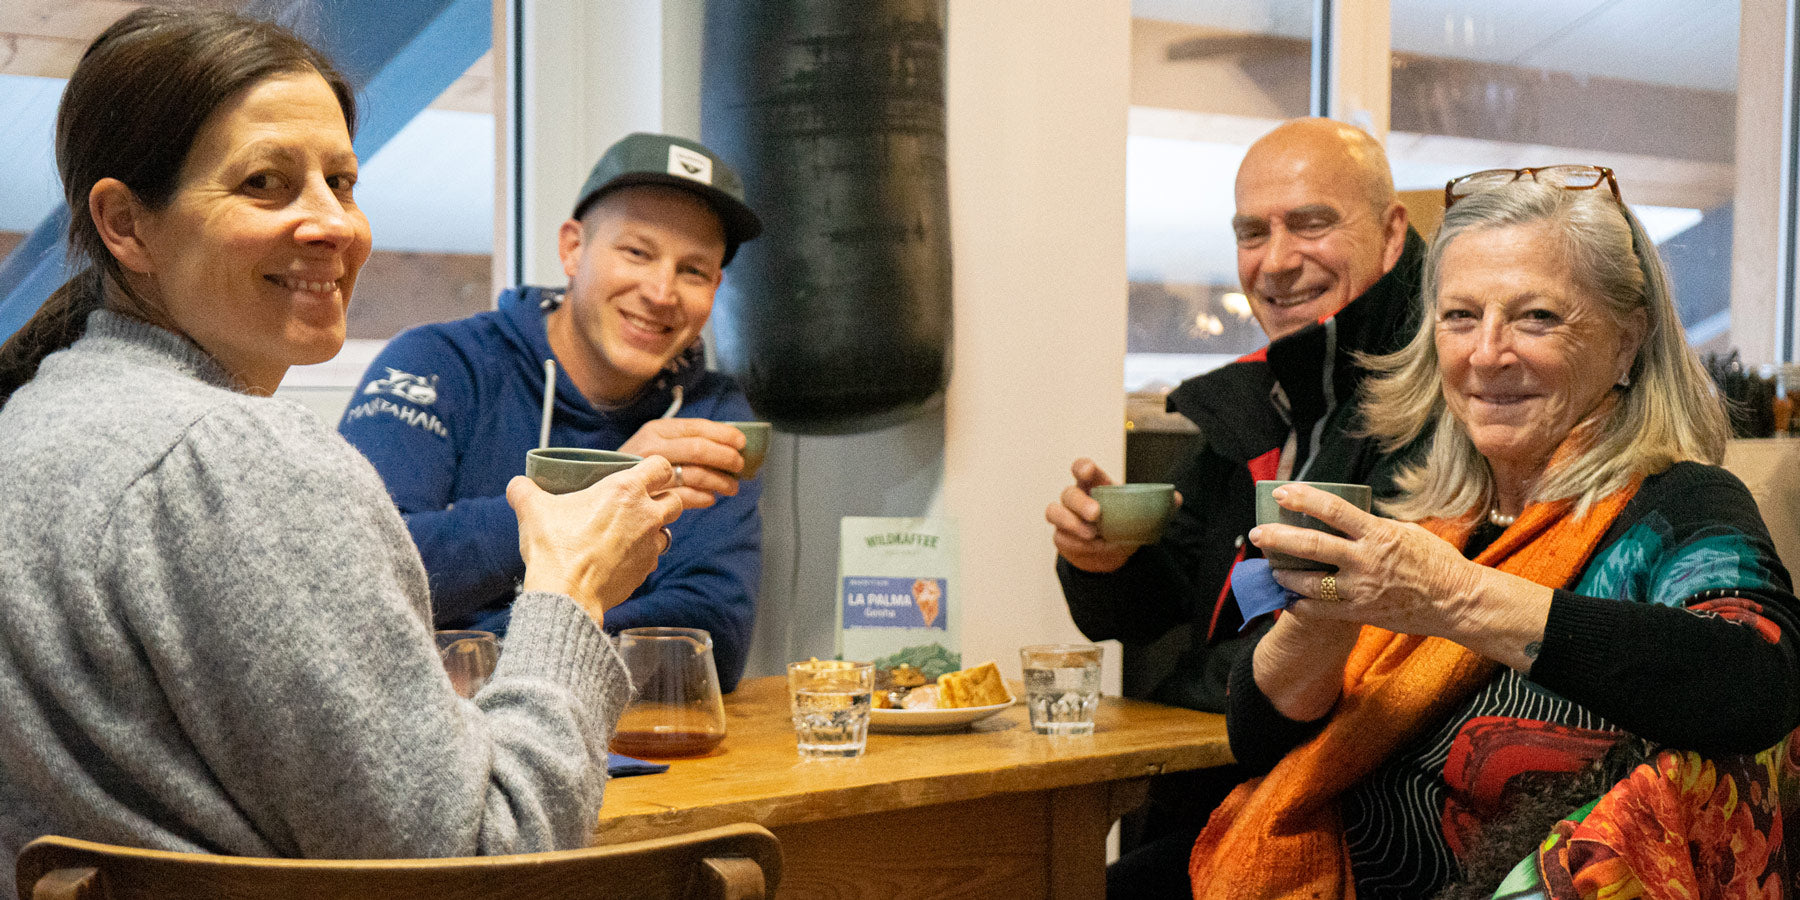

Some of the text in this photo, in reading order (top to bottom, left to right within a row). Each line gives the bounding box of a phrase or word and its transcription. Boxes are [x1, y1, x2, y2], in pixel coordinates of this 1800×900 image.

[865, 532, 939, 548] WILDKAFFEE
[847, 592, 912, 607] LA PALMA
